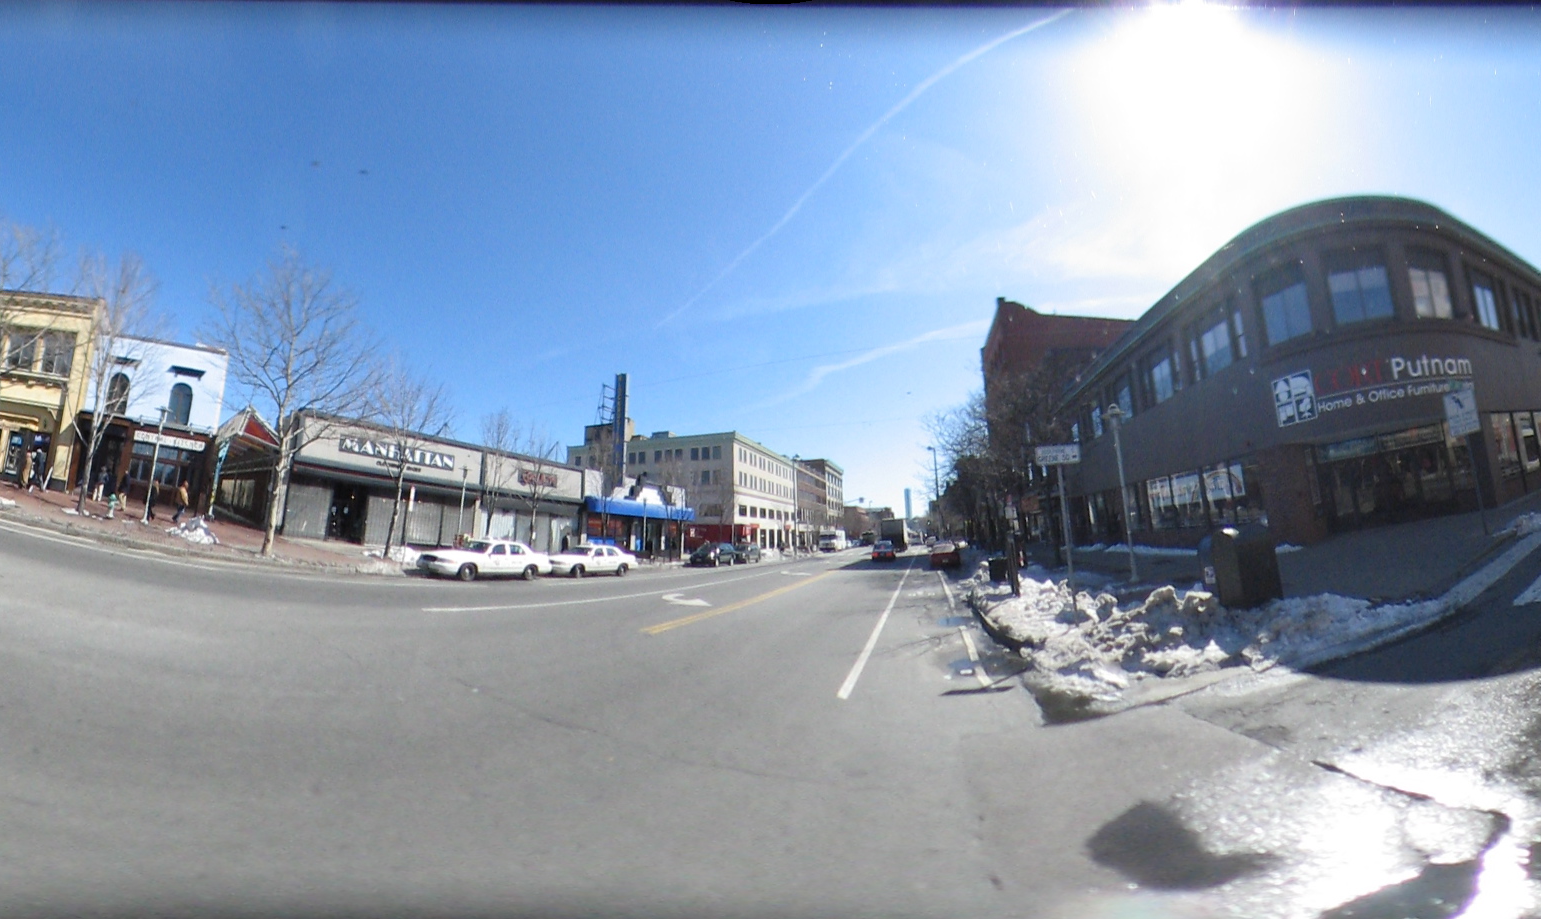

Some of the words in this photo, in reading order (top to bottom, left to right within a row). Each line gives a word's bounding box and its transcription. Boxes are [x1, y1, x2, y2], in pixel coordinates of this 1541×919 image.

[1391, 354, 1472, 380] Putnam
[1318, 398, 1353, 413] Home
[1356, 393, 1365, 405] &
[1368, 388, 1405, 403] Office
[1407, 381, 1450, 397] Furniture
